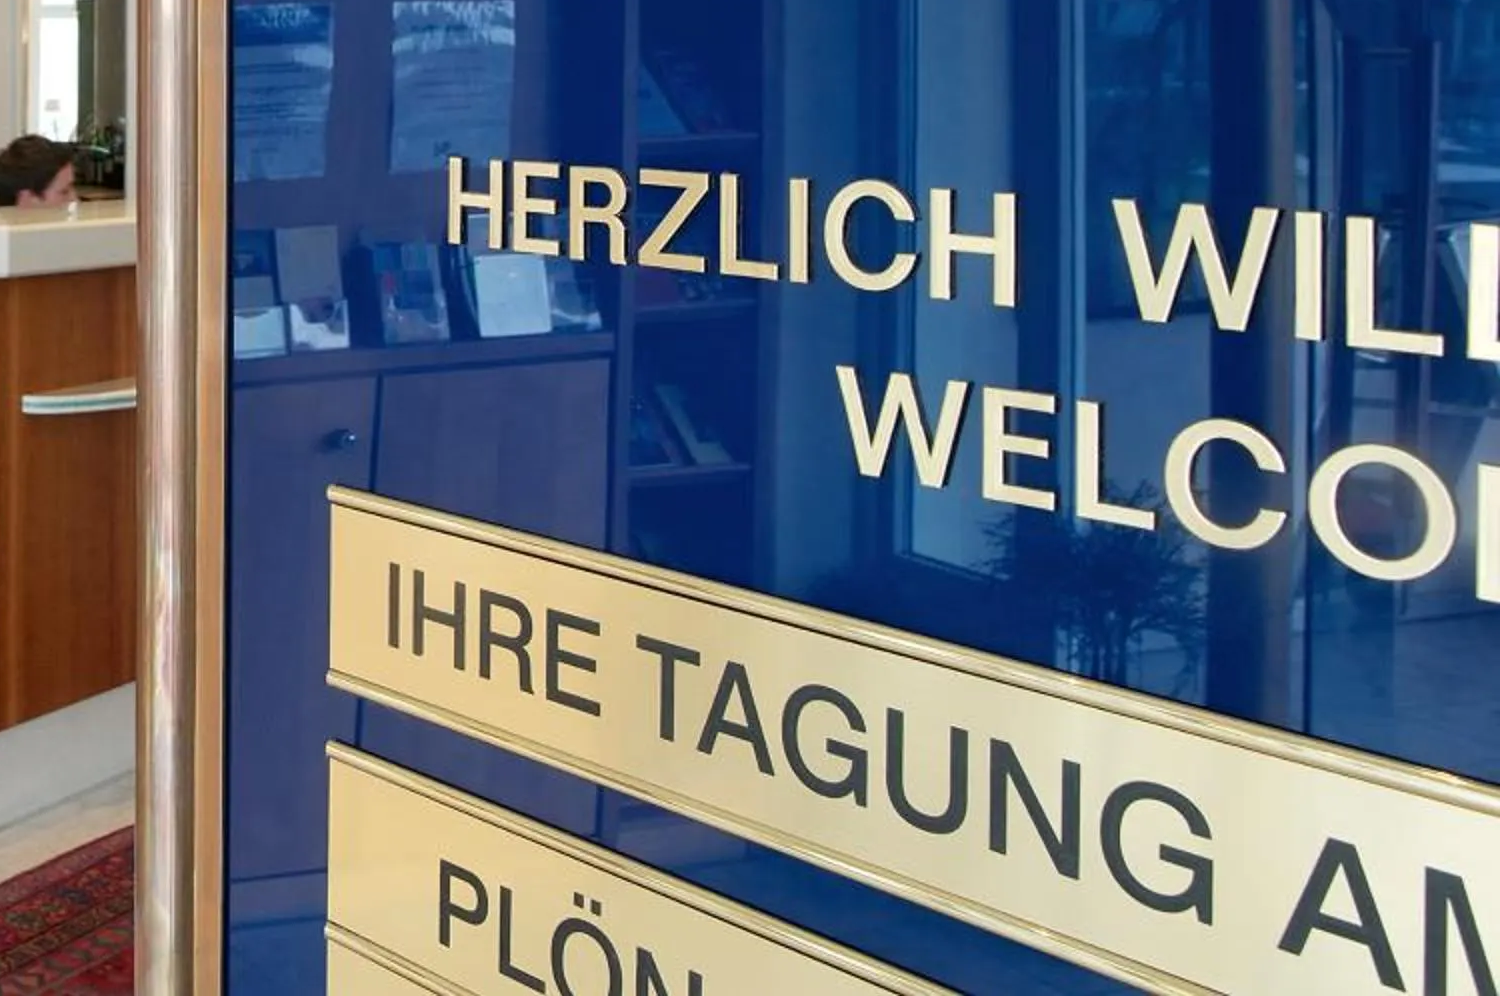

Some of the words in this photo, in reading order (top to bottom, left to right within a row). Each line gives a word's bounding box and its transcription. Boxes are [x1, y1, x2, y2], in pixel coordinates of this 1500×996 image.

[448, 156, 1016, 308] HERZLICH
[835, 365, 1500, 604] WELCO
[387, 561, 601, 718] IHRE
[636, 633, 1213, 927] TAGUNG
